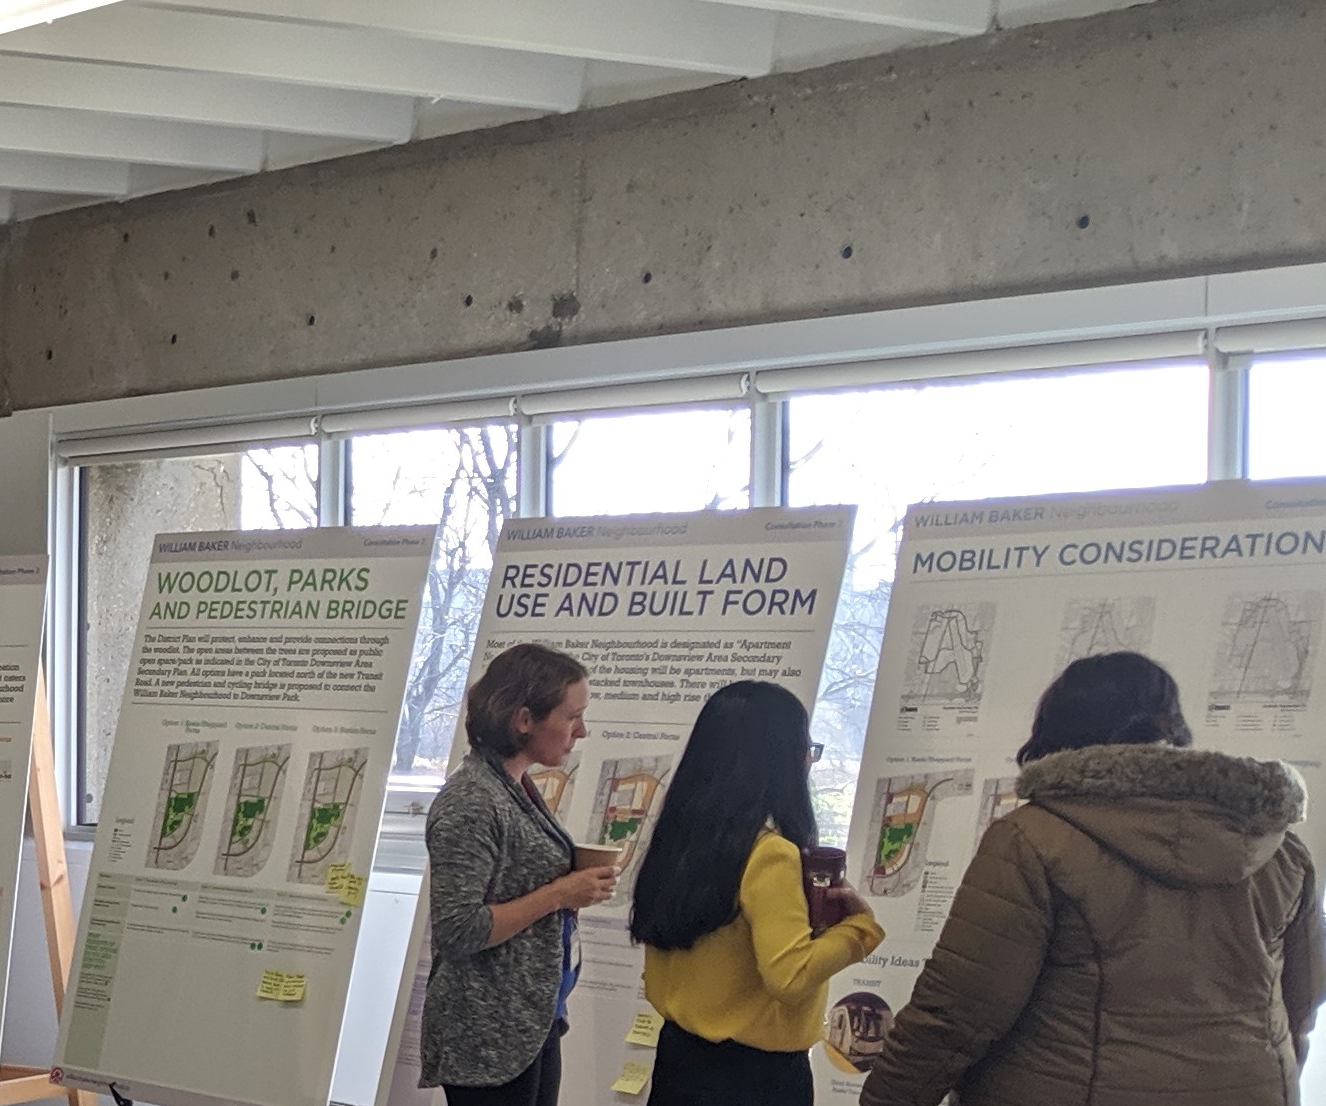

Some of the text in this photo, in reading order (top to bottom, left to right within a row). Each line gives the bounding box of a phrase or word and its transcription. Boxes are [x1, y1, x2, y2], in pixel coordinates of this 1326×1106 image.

[914, 511, 984, 528] WILLIAM
[988, 506, 1044, 524] BAKER
[507, 522, 688, 540] WILLIAM BAKER Neighbourhood
[159, 538, 302, 553] WILLIAM BAKER Neighbourhood
[912, 530, 1326, 574] MOBILITY CONSIDERATION
[501, 557, 788, 588] RESIDENTIAL LAND
[158, 567, 370, 597] WOODLOT, PARKS
[149, 599, 408, 620] AND PEDESTRIAN BRIDGE
[496, 588, 818, 618] USE AND BUILT FORM
[486, 640, 505, 649] Most
[565, 640, 589, 649] Baker
[591, 639, 659, 651] Neighbourhood
[661, 640, 668, 648] is
[670, 639, 721, 651] designated
[281, 658, 308, 667] Toronto
[353, 660, 373, 669] Area
[581, 652, 599, 663] City
[600, 652, 609, 661] of
[651, 652, 704, 662] Downsview
[706, 653, 729, 663] Area
[731, 653, 782, 665] Secondary
[598, 665, 801, 679] the housing will be apartments, but may also
[680, 679, 707, 688] There
[604, 691, 701, 704] medium and high rise
[890, 955, 920, 968] Ideas
